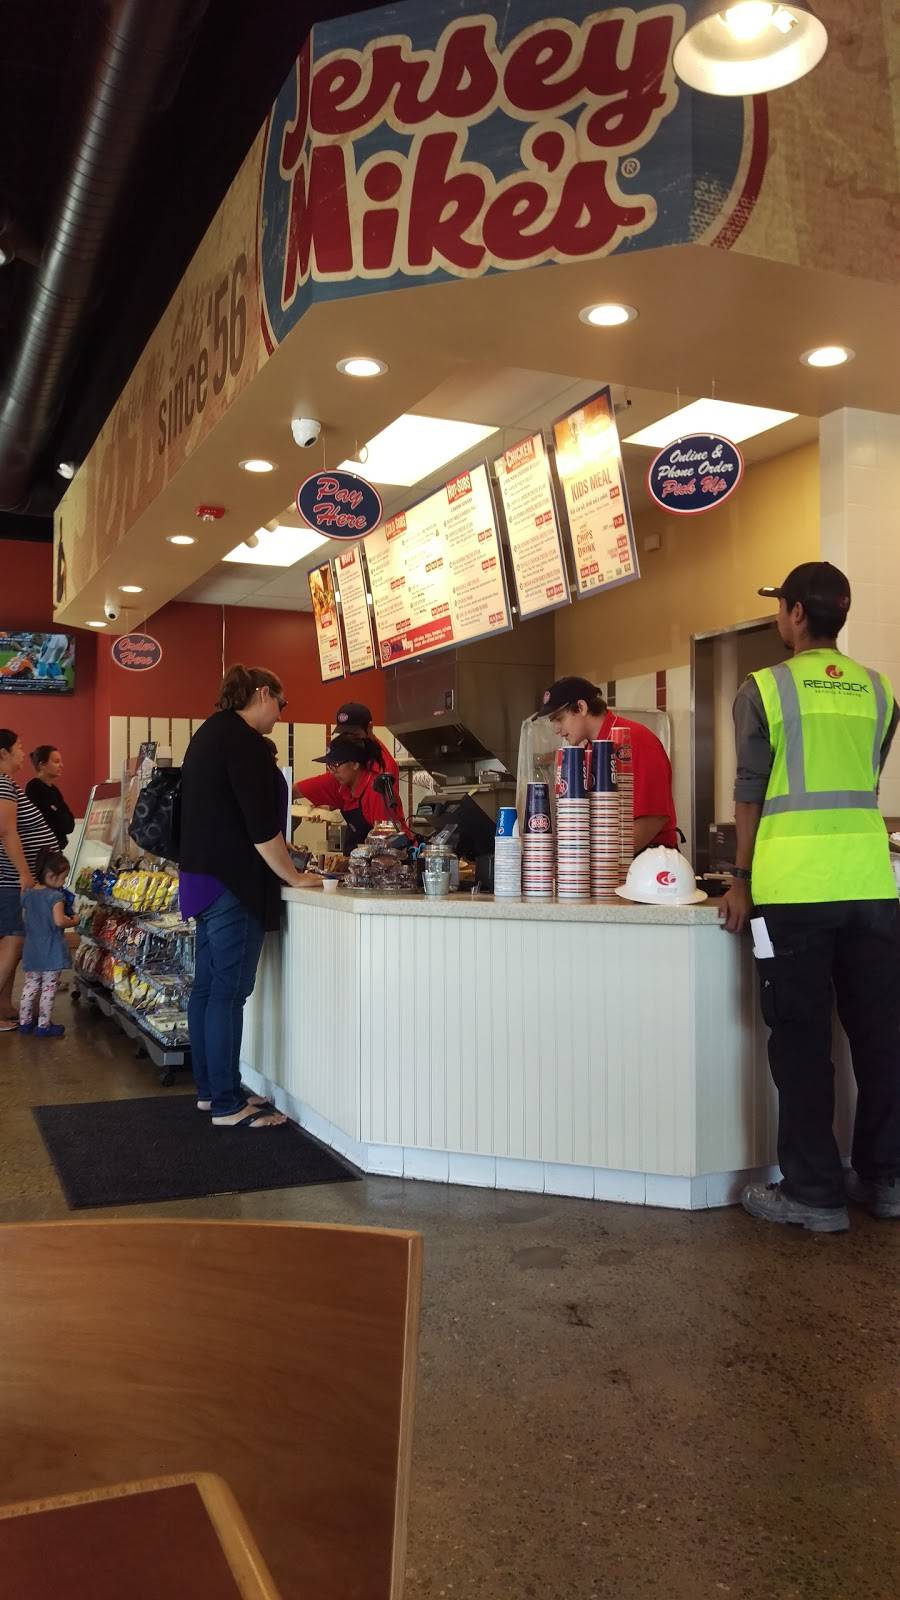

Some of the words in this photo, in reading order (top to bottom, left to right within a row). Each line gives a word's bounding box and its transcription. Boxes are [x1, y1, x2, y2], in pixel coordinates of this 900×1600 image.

[281, 8, 684, 168] Jersey
[281, 120, 655, 311] Mike's
[159, 347, 208, 454] since
[207, 252, 248, 396] '56
[669, 449, 708, 464] Online
[711, 443, 723, 459] &
[657, 465, 695, 481] Phone
[698, 460, 734, 475] Order
[317, 477, 363, 510] Pay
[570, 479, 589, 502] KIDS
[590, 468, 613, 492] MEAL
[661, 478, 696, 498] Pick
[700, 475, 727, 496] Up
[313, 502, 367, 529] Here
[576, 529, 594, 545] CHIPS
[577, 543, 596, 558] DRINK
[119, 637, 155, 651] Order
[119, 651, 153, 664] Here
[803, 680, 872, 694] REDROCK
